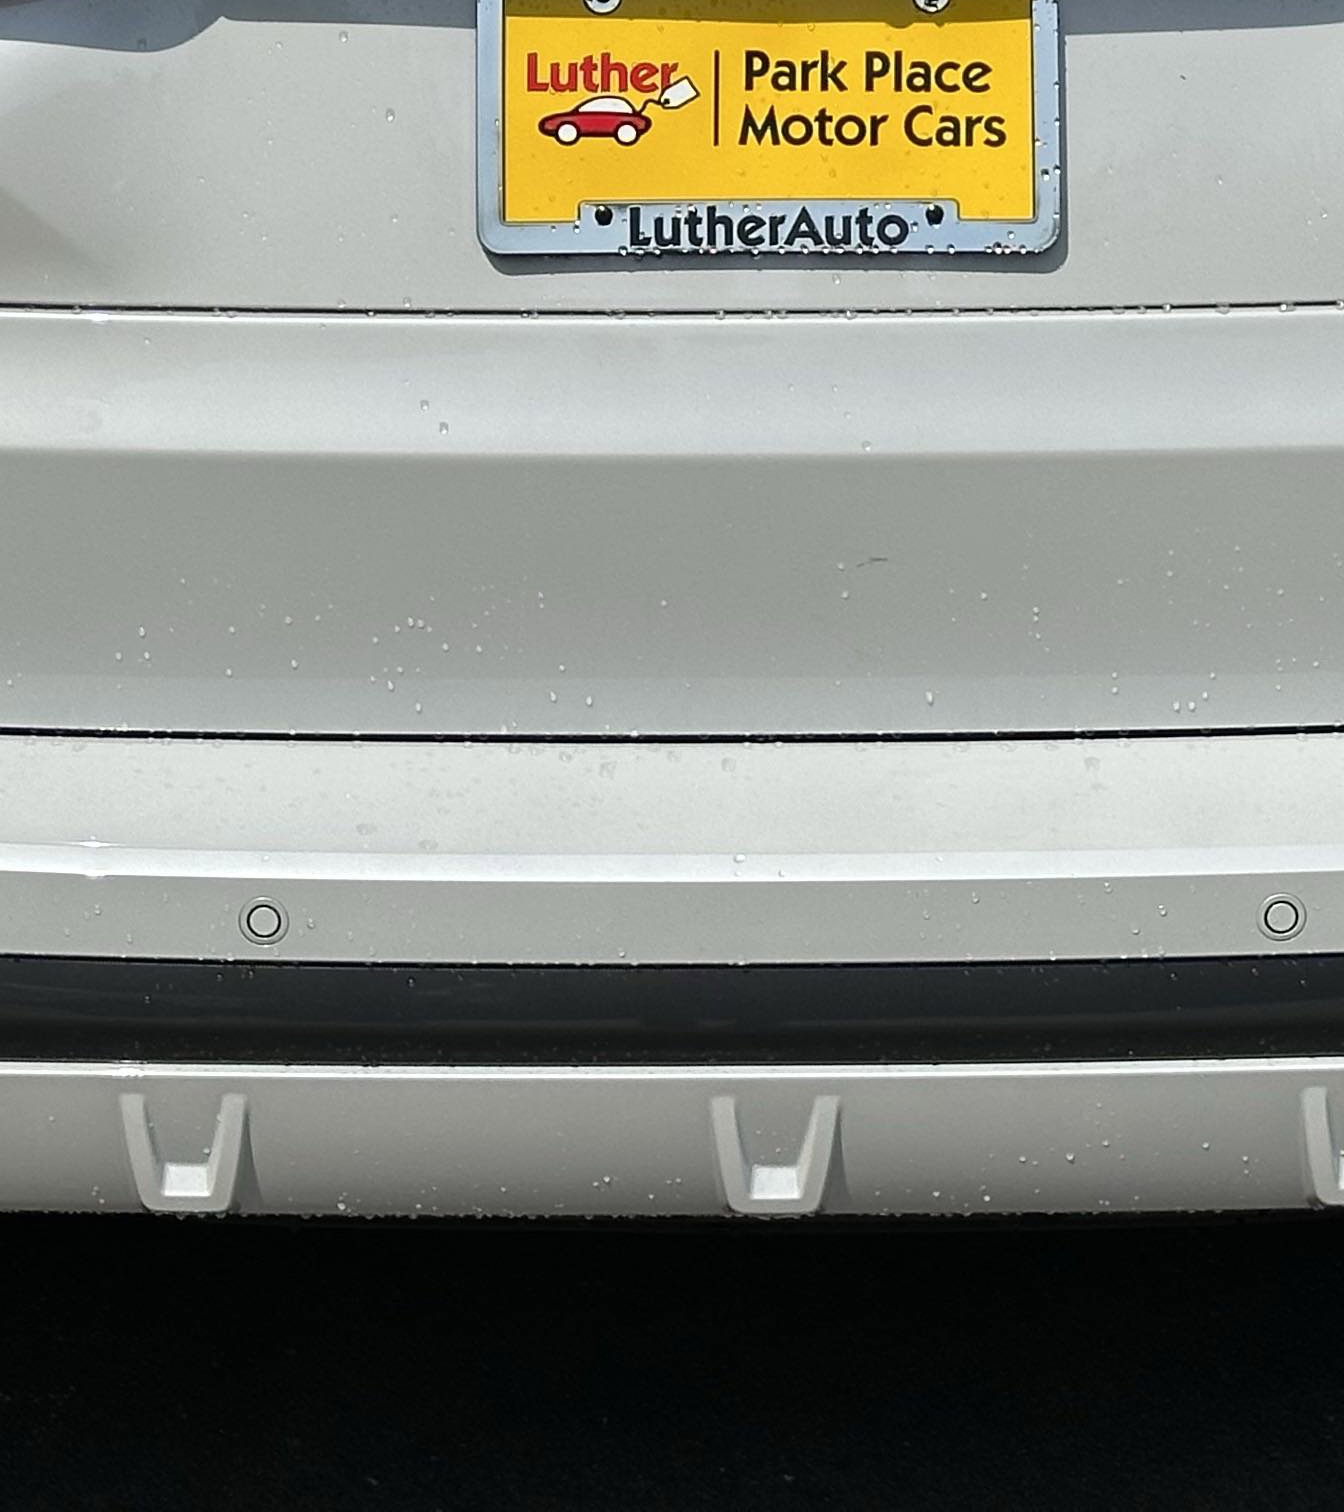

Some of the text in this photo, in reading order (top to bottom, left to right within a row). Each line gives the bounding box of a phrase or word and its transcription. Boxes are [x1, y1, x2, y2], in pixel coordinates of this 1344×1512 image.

[527, 51, 679, 93] Luther
[744, 50, 992, 93] Park Place
[738, 104, 1007, 147] Motor Cars
[627, 205, 910, 248] LutherAuto
